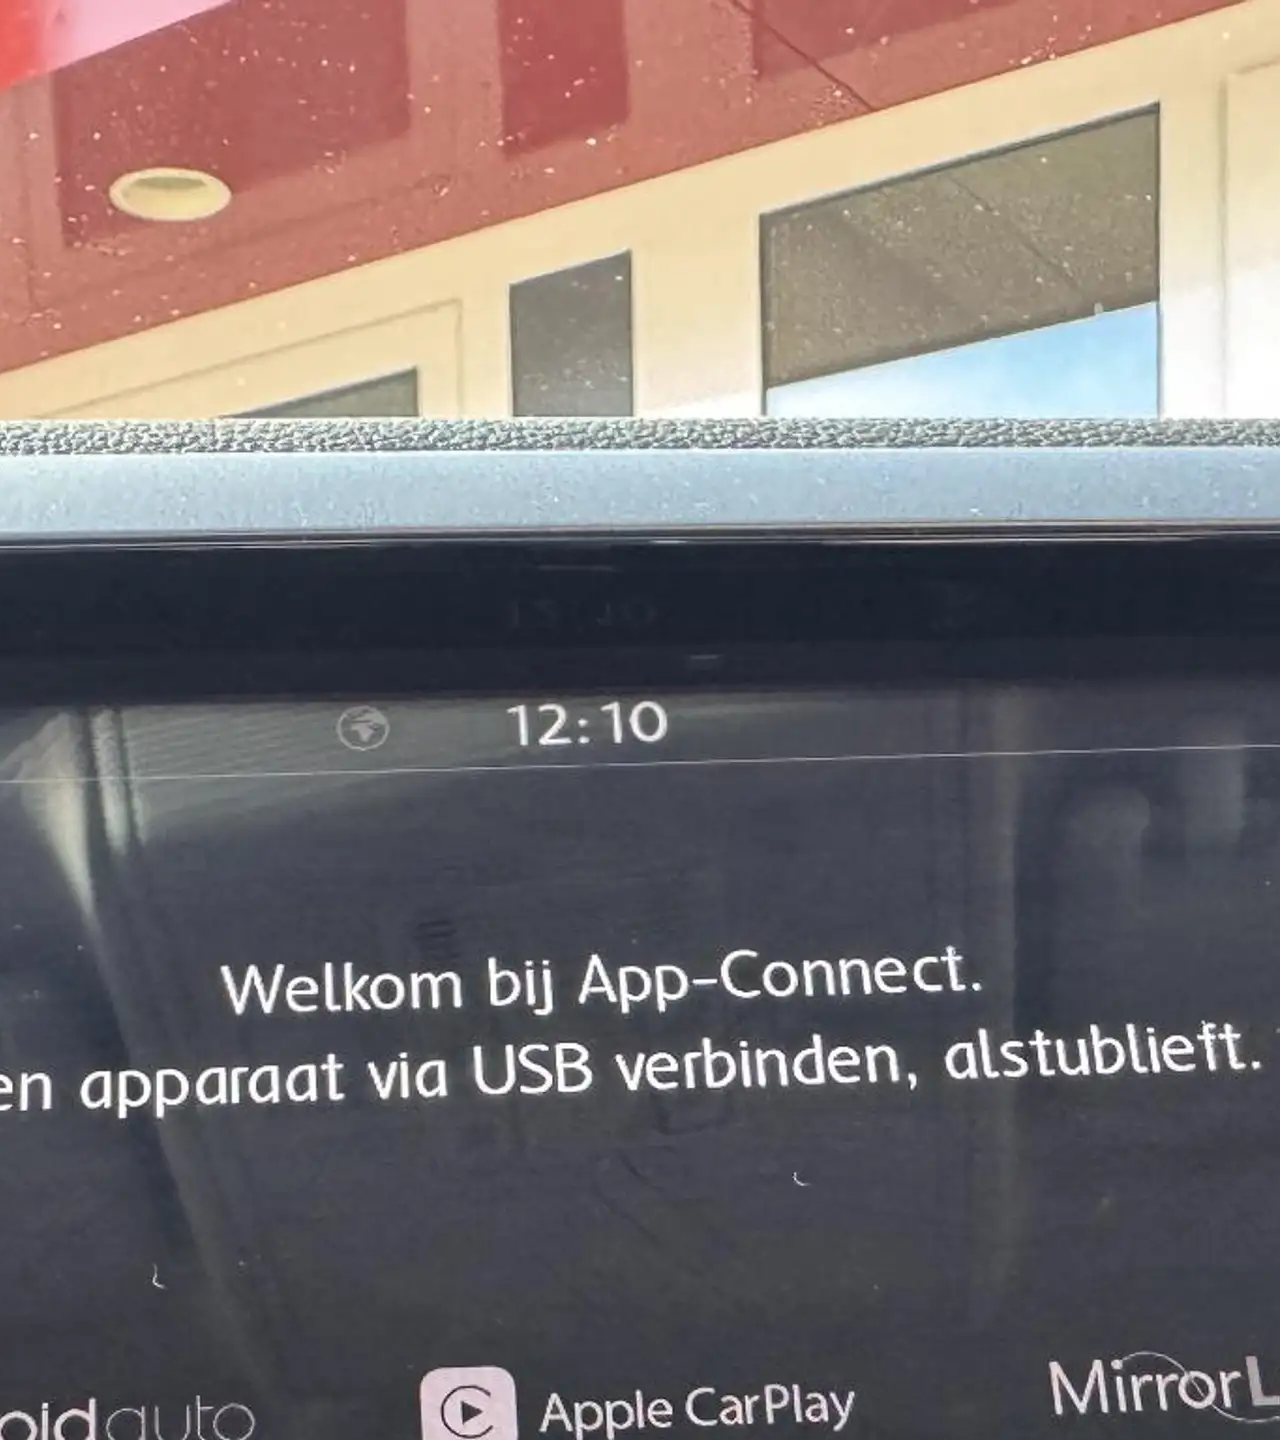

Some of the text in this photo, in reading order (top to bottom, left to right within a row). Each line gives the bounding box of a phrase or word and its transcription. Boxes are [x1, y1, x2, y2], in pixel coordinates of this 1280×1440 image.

[506, 700, 668, 747] 12:10
[220, 945, 982, 1016] Welkom bij App-Connect.
[79, 1053, 345, 1119] apparaat
[367, 1051, 448, 1100] via
[472, 1042, 593, 1095] USB
[614, 1033, 917, 1091] verbinden,
[944, 1022, 1261, 1080] alstublieft.
[685, 1383, 855, 1432] CarPlay
